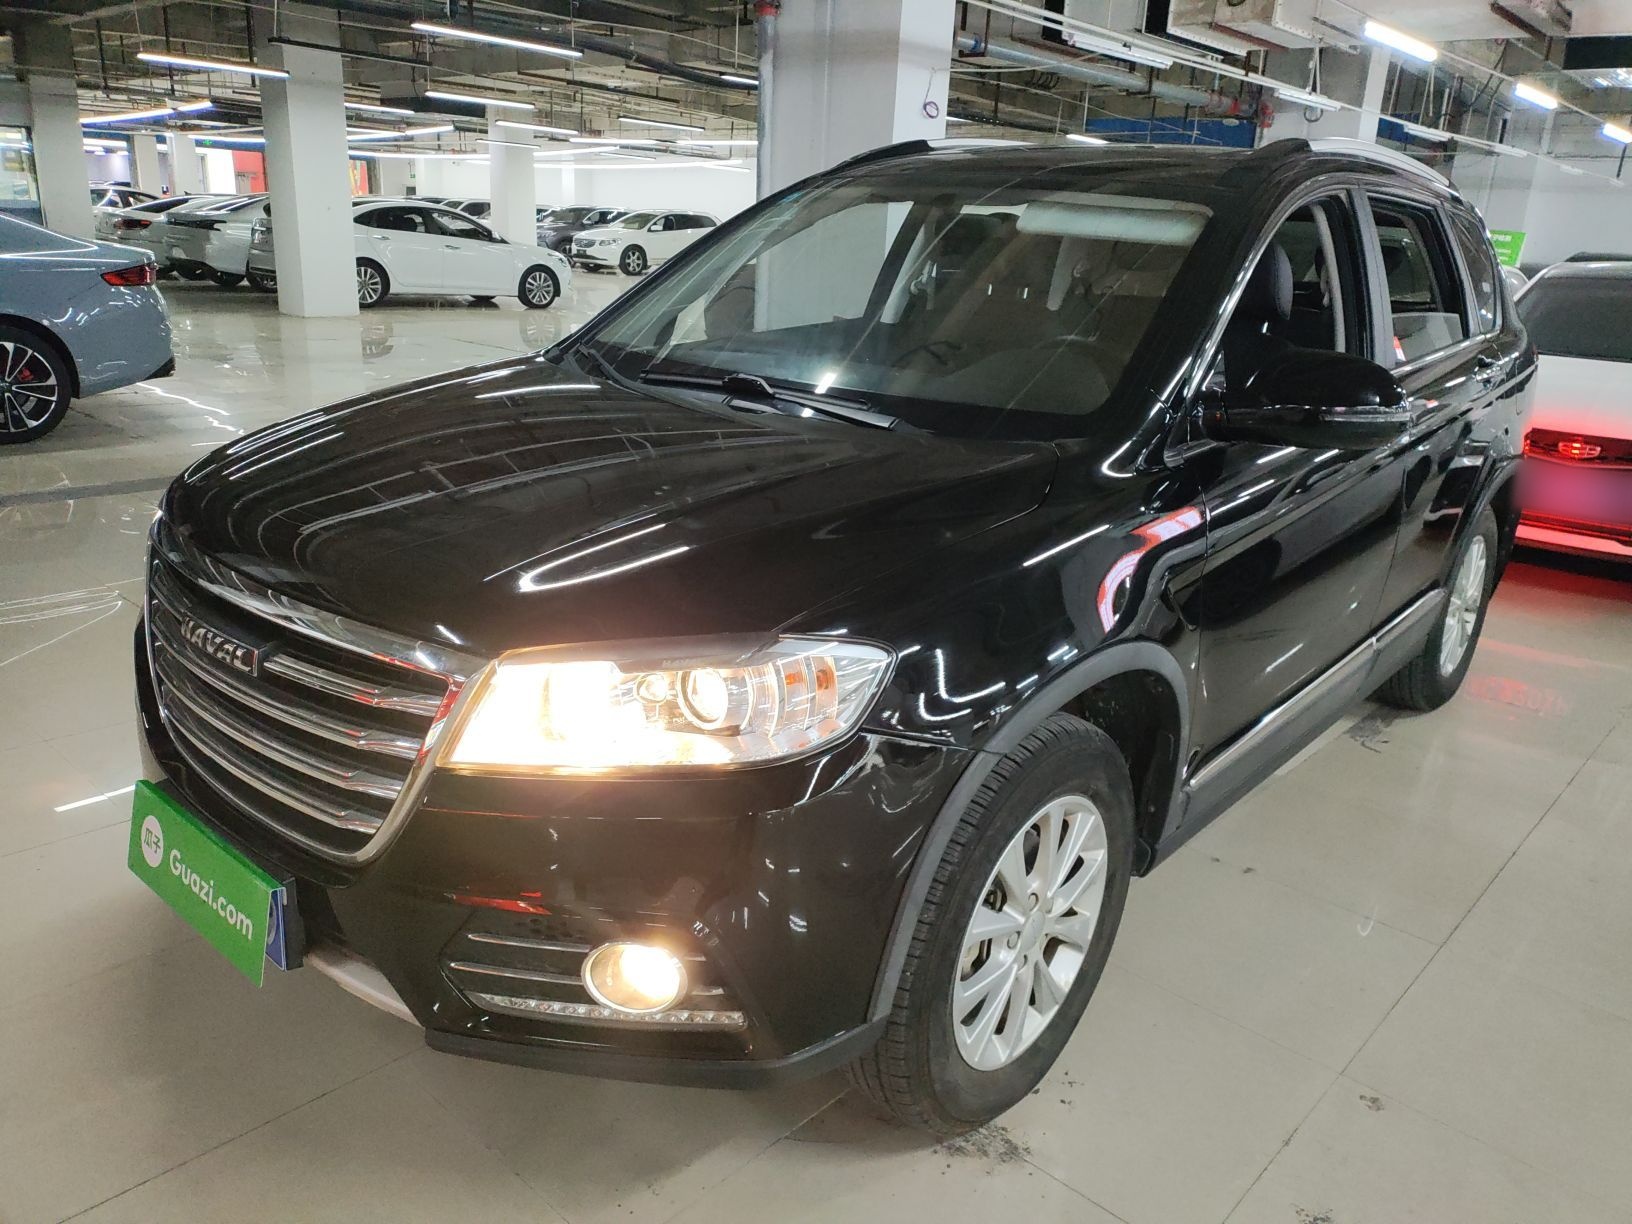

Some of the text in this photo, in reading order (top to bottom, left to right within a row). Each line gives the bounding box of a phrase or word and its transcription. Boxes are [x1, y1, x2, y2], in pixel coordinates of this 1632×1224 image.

[181, 617, 252, 672] HAVAL
[144, 827, 161, 854] 瓜子
[169, 849, 253, 940] Guazi.com
